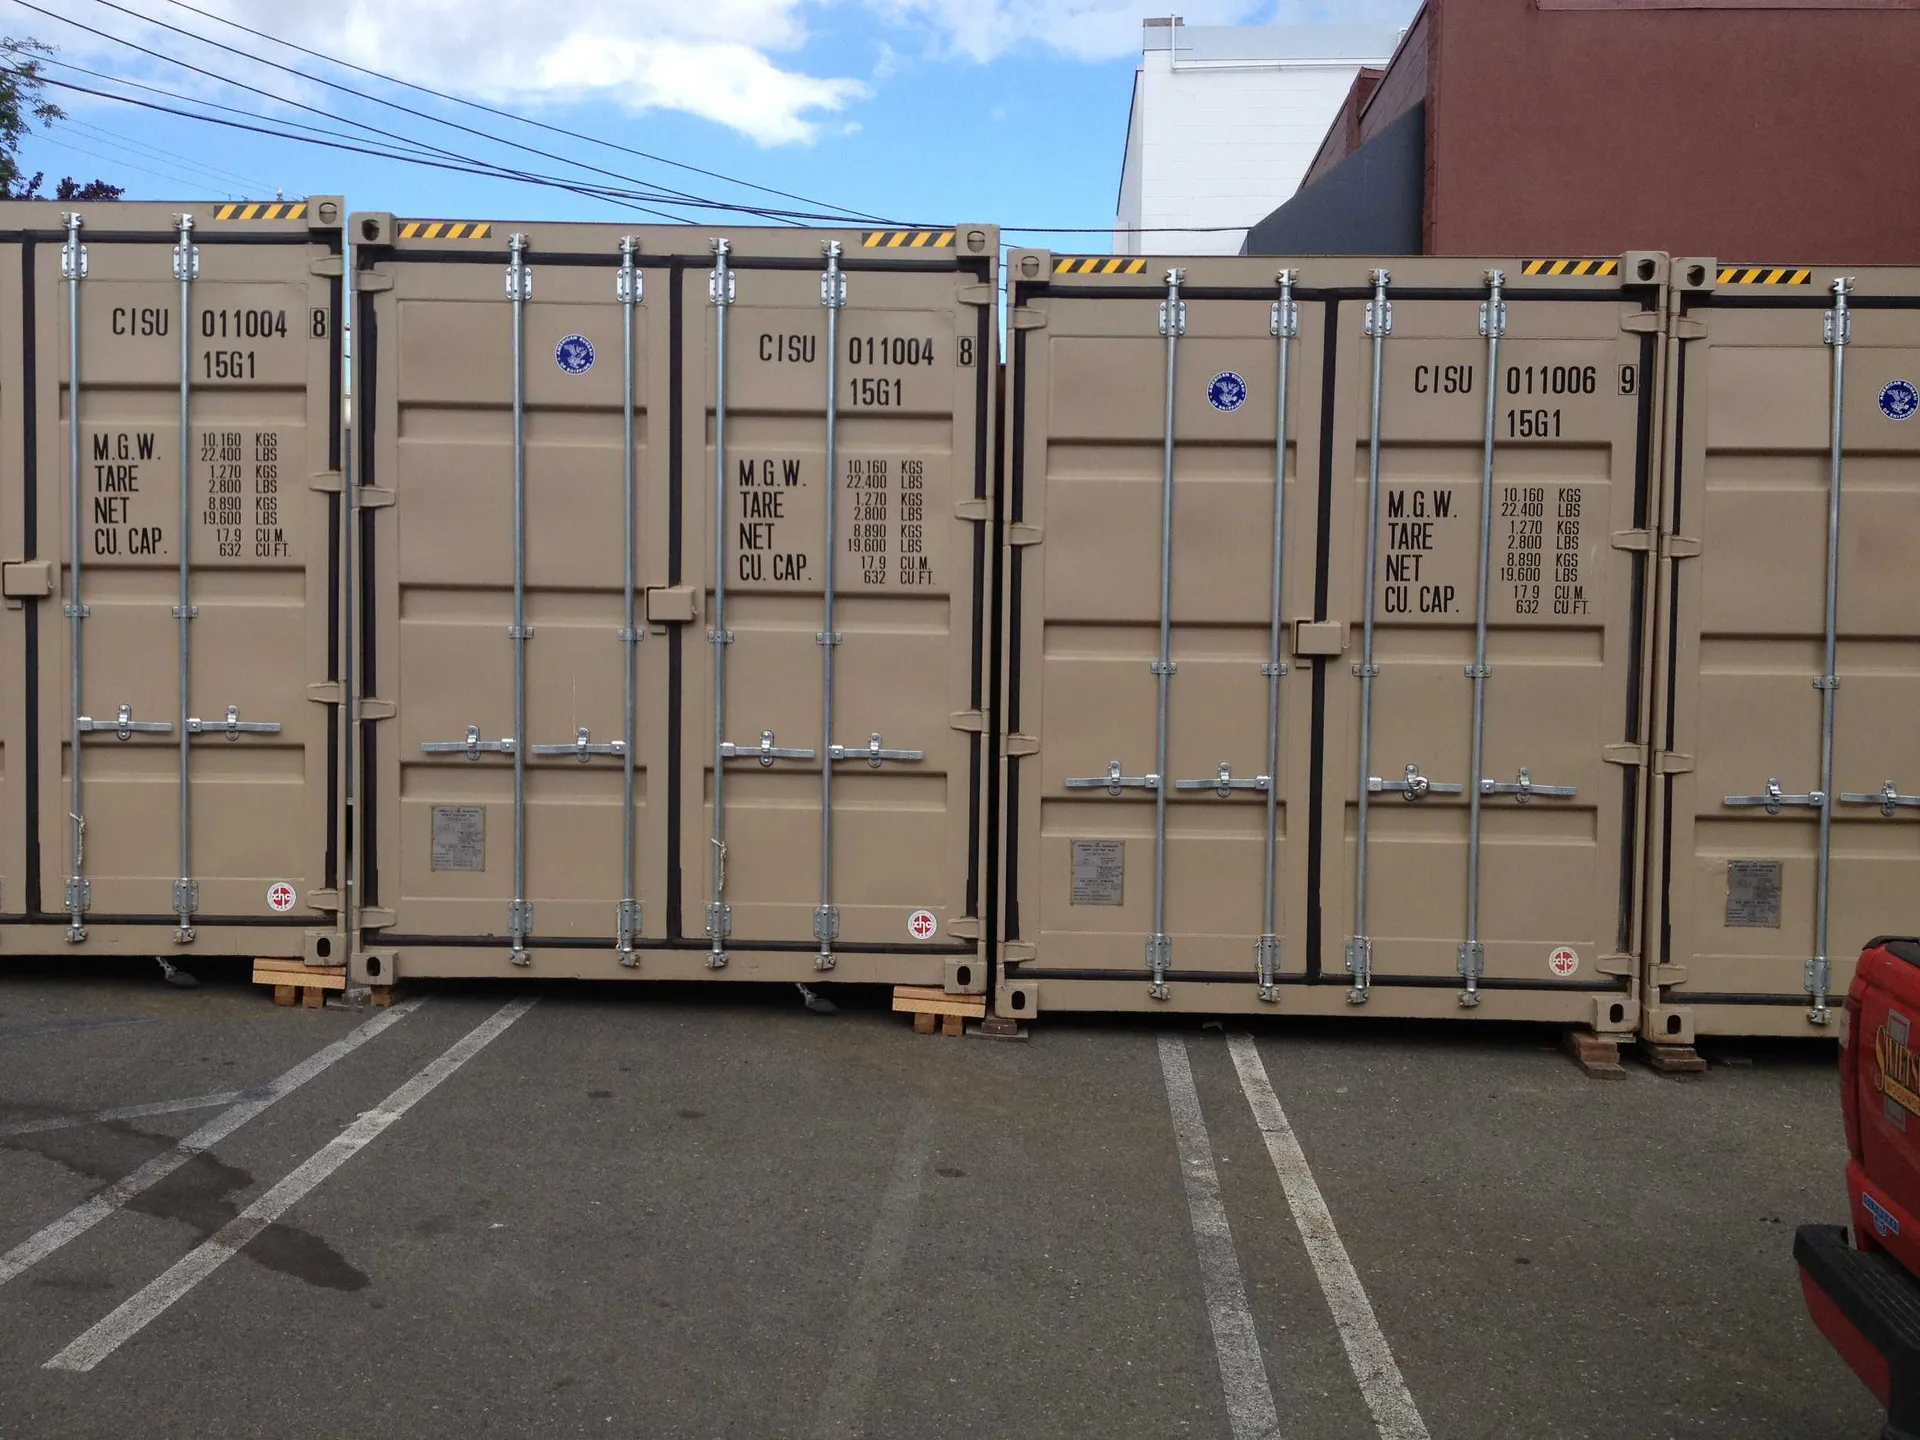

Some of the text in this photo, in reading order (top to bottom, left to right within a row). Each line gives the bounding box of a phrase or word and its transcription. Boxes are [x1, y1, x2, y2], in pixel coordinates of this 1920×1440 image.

[113, 308, 326, 338] CISU 011004 8
[759, 334, 972, 365] CISU 011004 8
[203, 351, 256, 379] 15G1
[1414, 366, 1634, 394] CISU 011006 9
[850, 378, 902, 406] 15G1
[1507, 409, 1561, 437] 15G1
[255, 433, 277, 446] KGS
[94, 433, 161, 461] M.G.W.
[255, 448, 277, 461] LBS
[255, 465, 277, 479] KGS
[739, 460, 806, 487] M.G.W.
[901, 460, 923, 474] KGS
[94, 465, 139, 492] TARE
[901, 475, 923, 489] LBS
[255, 480, 277, 493] LBS
[901, 492, 922, 506] KGS
[1558, 488, 1581, 502] KGS
[94, 497, 130, 524] NET
[255, 497, 277, 510] KGS
[740, 492, 784, 518] TARE
[1388, 491, 1457, 518] M.G.W.
[1558, 503, 1580, 517] LBS
[255, 511, 277, 525] LBS
[900, 507, 922, 521] LBS
[900, 524, 922, 538] KGS
[1557, 521, 1580, 534] KGS
[94, 528, 168, 555] CU. CAP.
[216, 529, 241, 542] 17.9
[740, 523, 774, 550] NET
[1388, 523, 1434, 549] TARE
[219, 543, 241, 557] 632
[900, 539, 922, 553] LBS
[1556, 536, 1579, 550] LBS
[861, 556, 886, 570] 17.9
[1556, 553, 1578, 567] KGS
[740, 554, 812, 581] CU. CAP.
[1386, 555, 1422, 582] NET
[864, 570, 886, 584] 632
[1555, 568, 1578, 582] LBS
[1513, 585, 1540, 599] 17.9
[1385, 586, 1459, 613] CU. CAP.
[1516, 600, 1539, 614] 632
